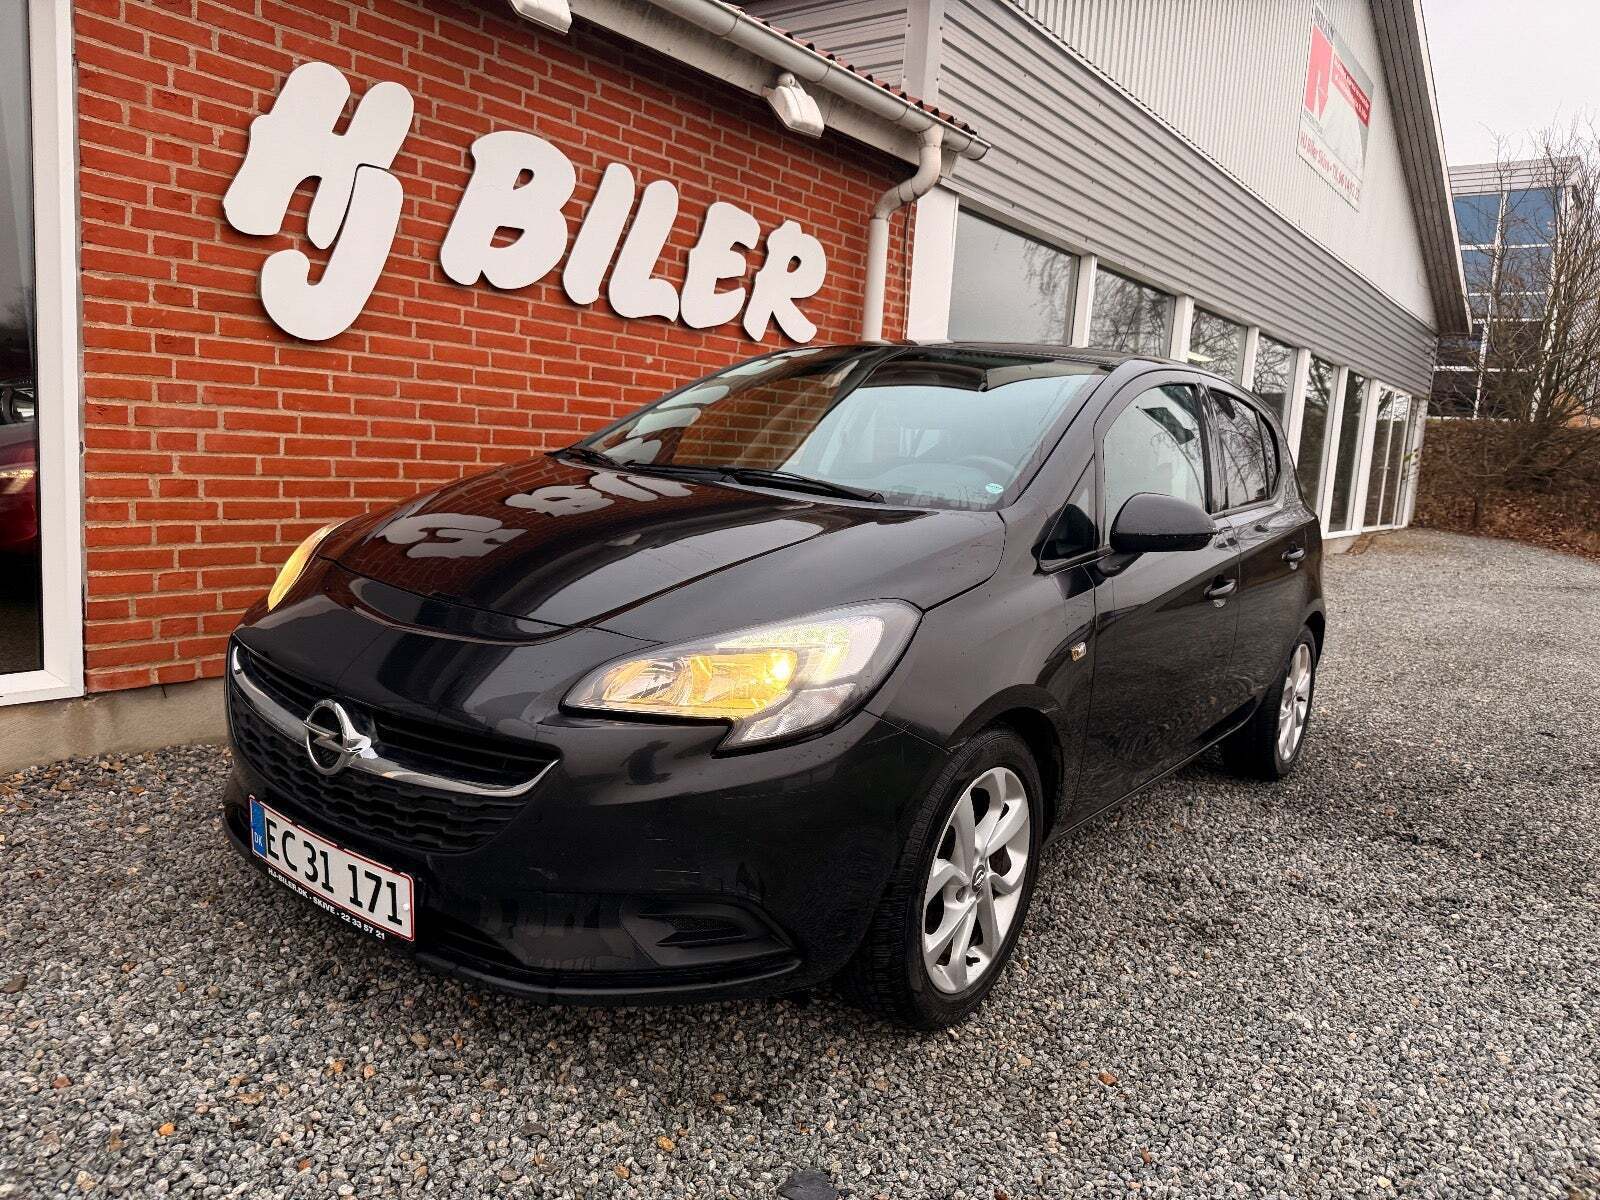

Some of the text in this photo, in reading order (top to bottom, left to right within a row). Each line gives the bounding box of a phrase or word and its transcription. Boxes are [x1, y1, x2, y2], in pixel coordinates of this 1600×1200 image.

[440, 130, 828, 344] BILER
[254, 831, 264, 847] DK
[265, 816, 403, 926] EC 31 171
[267, 867, 309, 899] HJ-BILER.DK
[312, 896, 336, 915] SKIVE
[340, 911, 351, 923] 22
[351, 918, 362, 929] 33
[375, 929, 385, 940] 21
